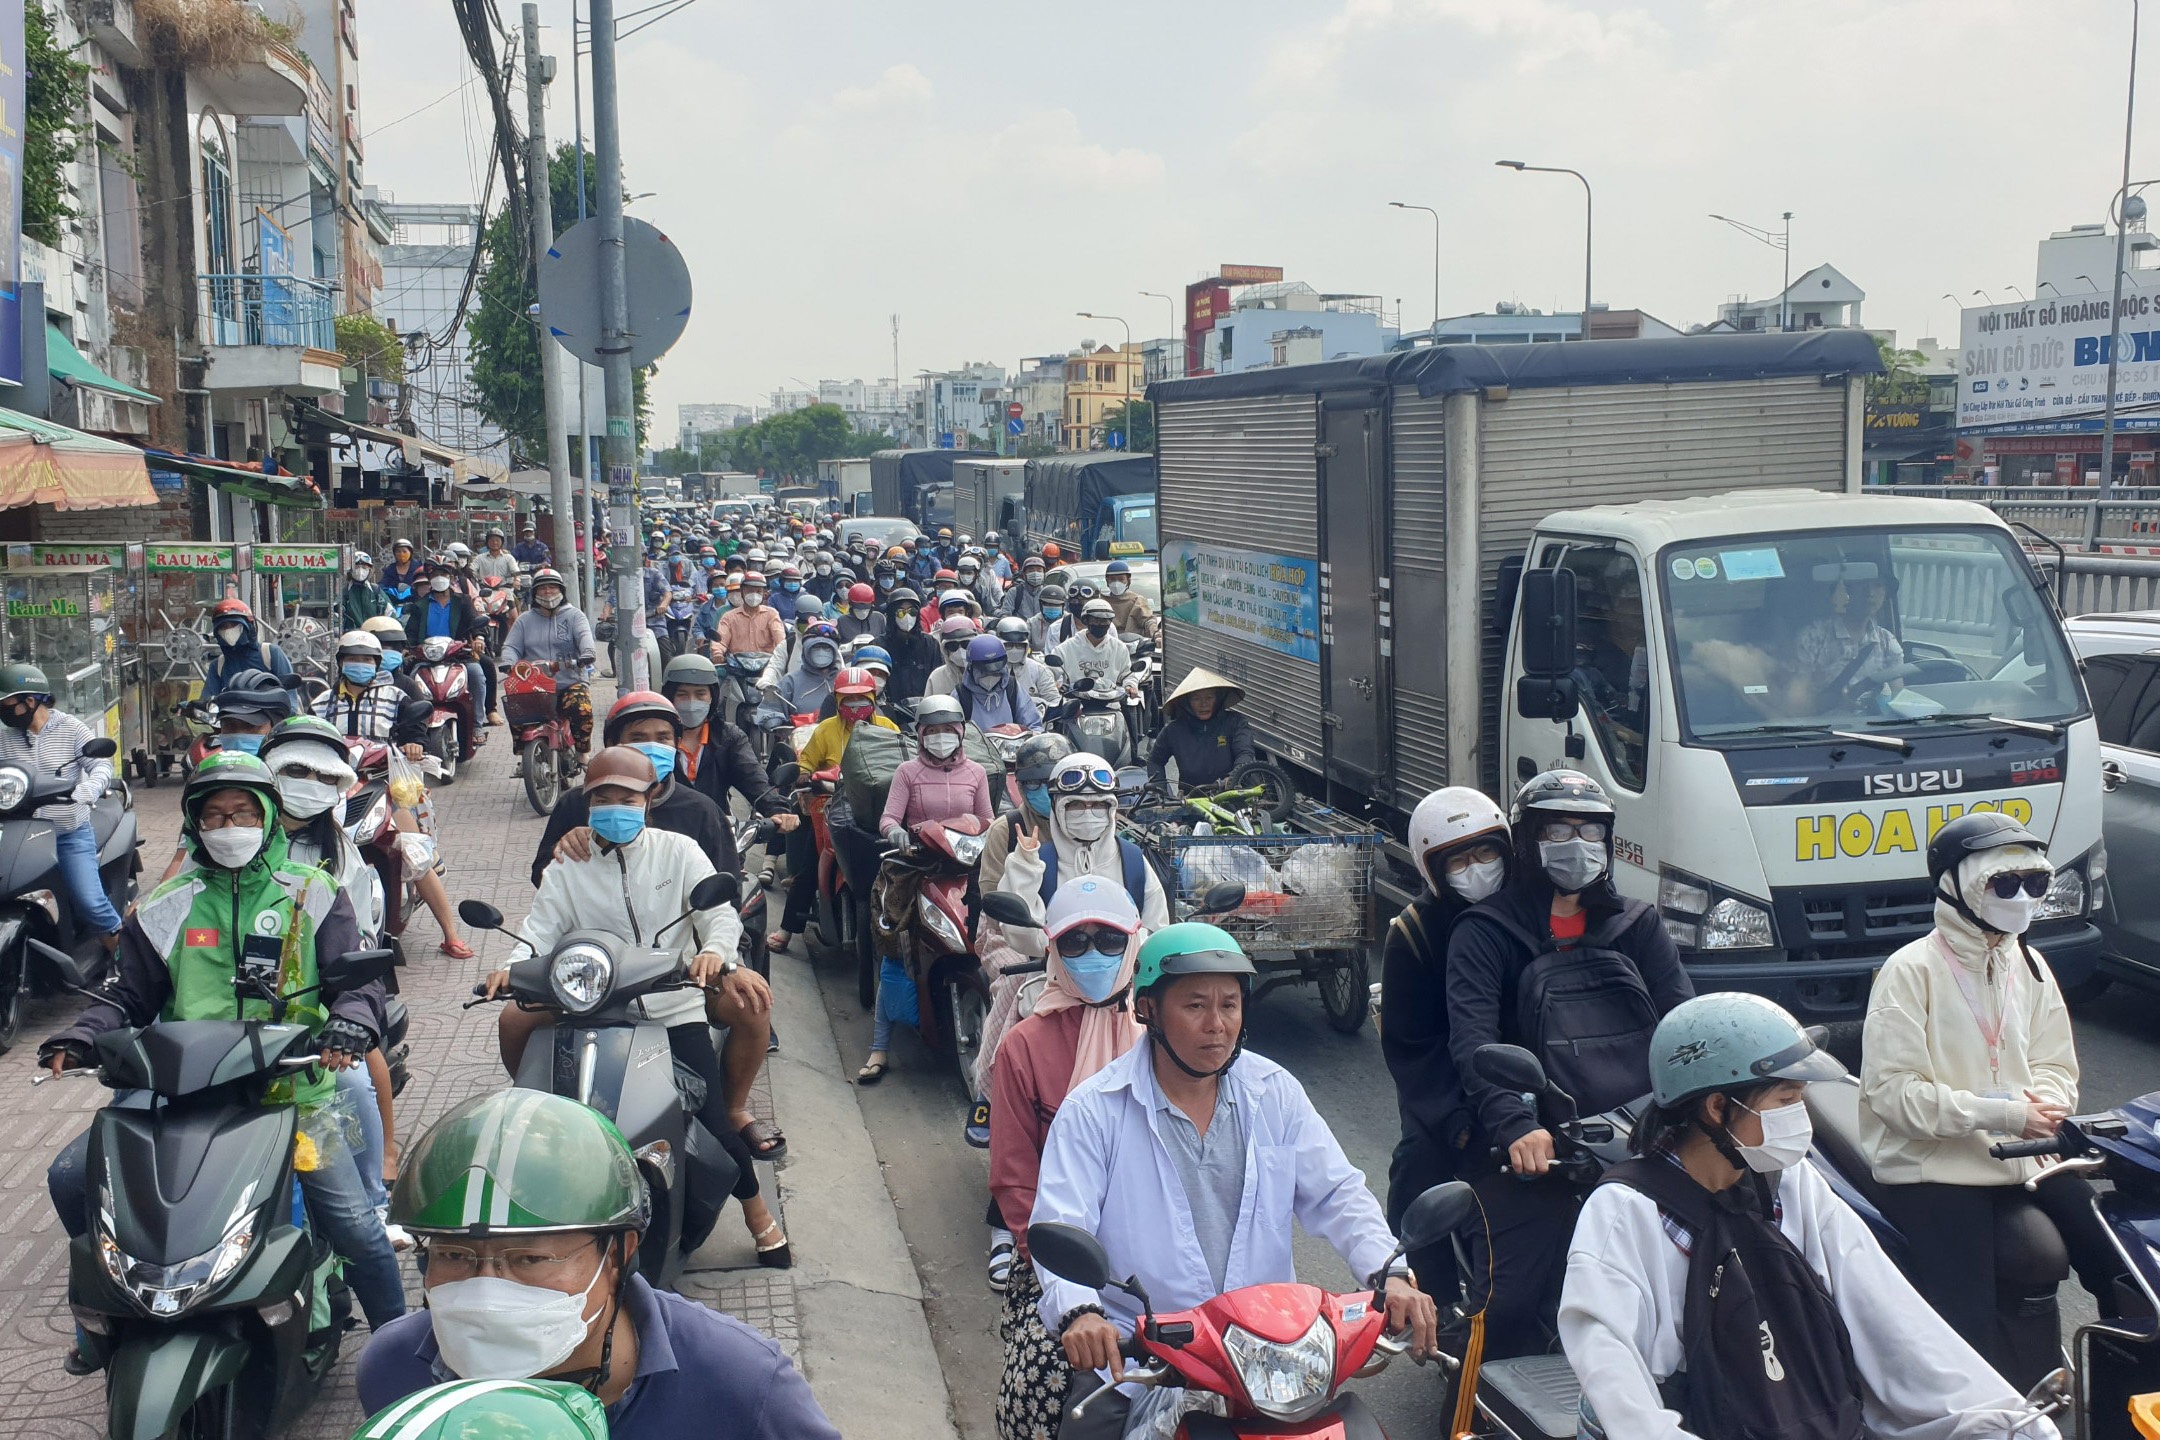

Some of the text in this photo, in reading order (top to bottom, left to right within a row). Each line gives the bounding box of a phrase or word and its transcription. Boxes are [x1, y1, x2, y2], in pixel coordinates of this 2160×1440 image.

[1978, 312, 2000, 335] NỘI
[2004, 305, 2036, 329] THẤT
[2039, 302, 2057, 325] GỖ
[2061, 300, 2110, 324] HOÀNG
[1965, 344, 1997, 376] SÀN
[2003, 336, 2025, 374] GỖ
[2029, 336, 2064, 370] ĐỨC
[2099, 369, 2131, 385] NỚC
[2091, 394, 2107, 404] THAN
[45, 551, 111, 566] RAU MÁ
[156, 551, 221, 567] RAU MÁ
[264, 552, 327, 567] RAU MÁ
[8, 598, 79, 617] Rau Má
[2010, 757, 2056, 771] QKR
[1864, 769, 1963, 795] ISUZU
[2011, 768, 2060, 784] 270
[1615, 836, 1644, 857] QKR
[1615, 846, 1644, 867] 270
[655, 878, 672, 891] GUCCI
[974, 1105, 988, 1124] C
